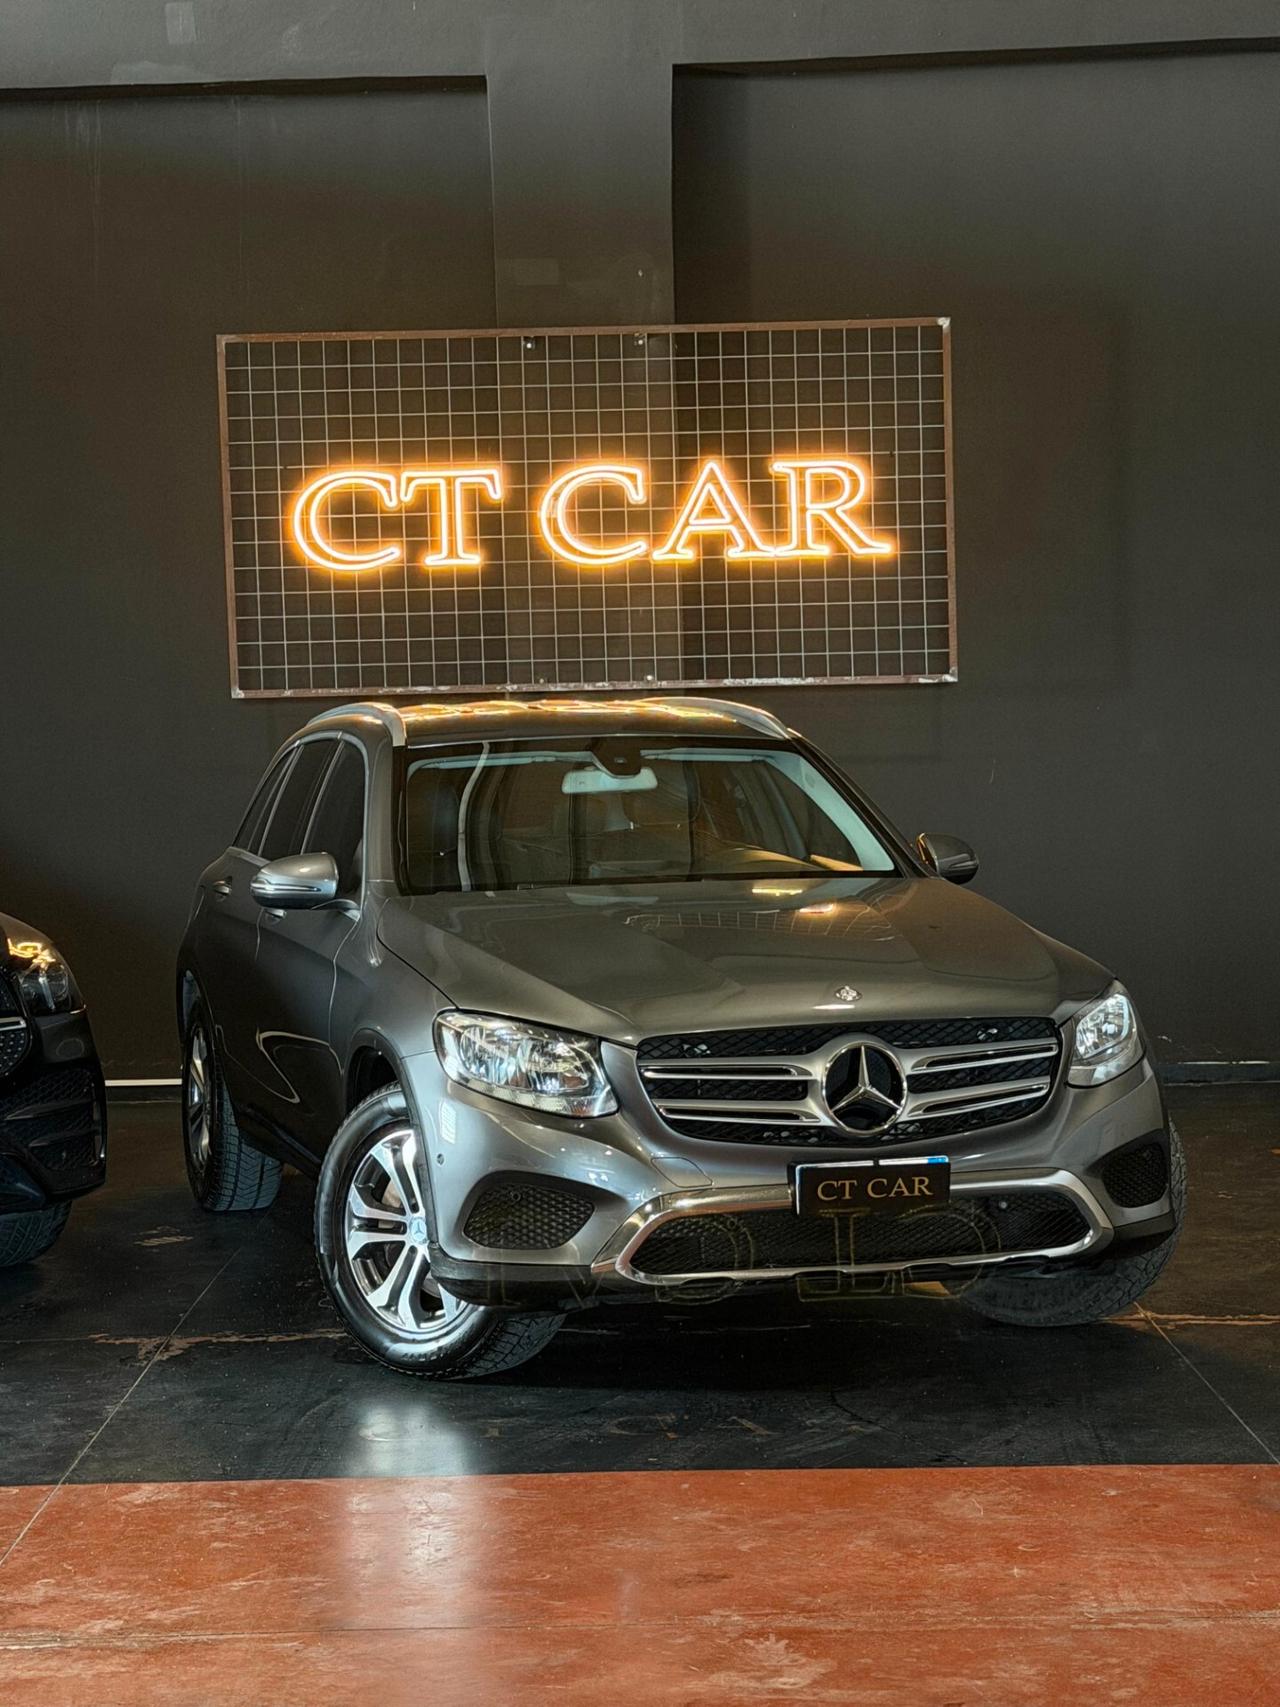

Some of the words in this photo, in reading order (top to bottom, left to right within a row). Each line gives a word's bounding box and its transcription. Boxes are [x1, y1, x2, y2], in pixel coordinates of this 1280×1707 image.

[291, 467, 504, 572] CT
[538, 459, 894, 566] CAR
[817, 1179, 858, 1201] CT
[866, 1176, 934, 1199] CAR
